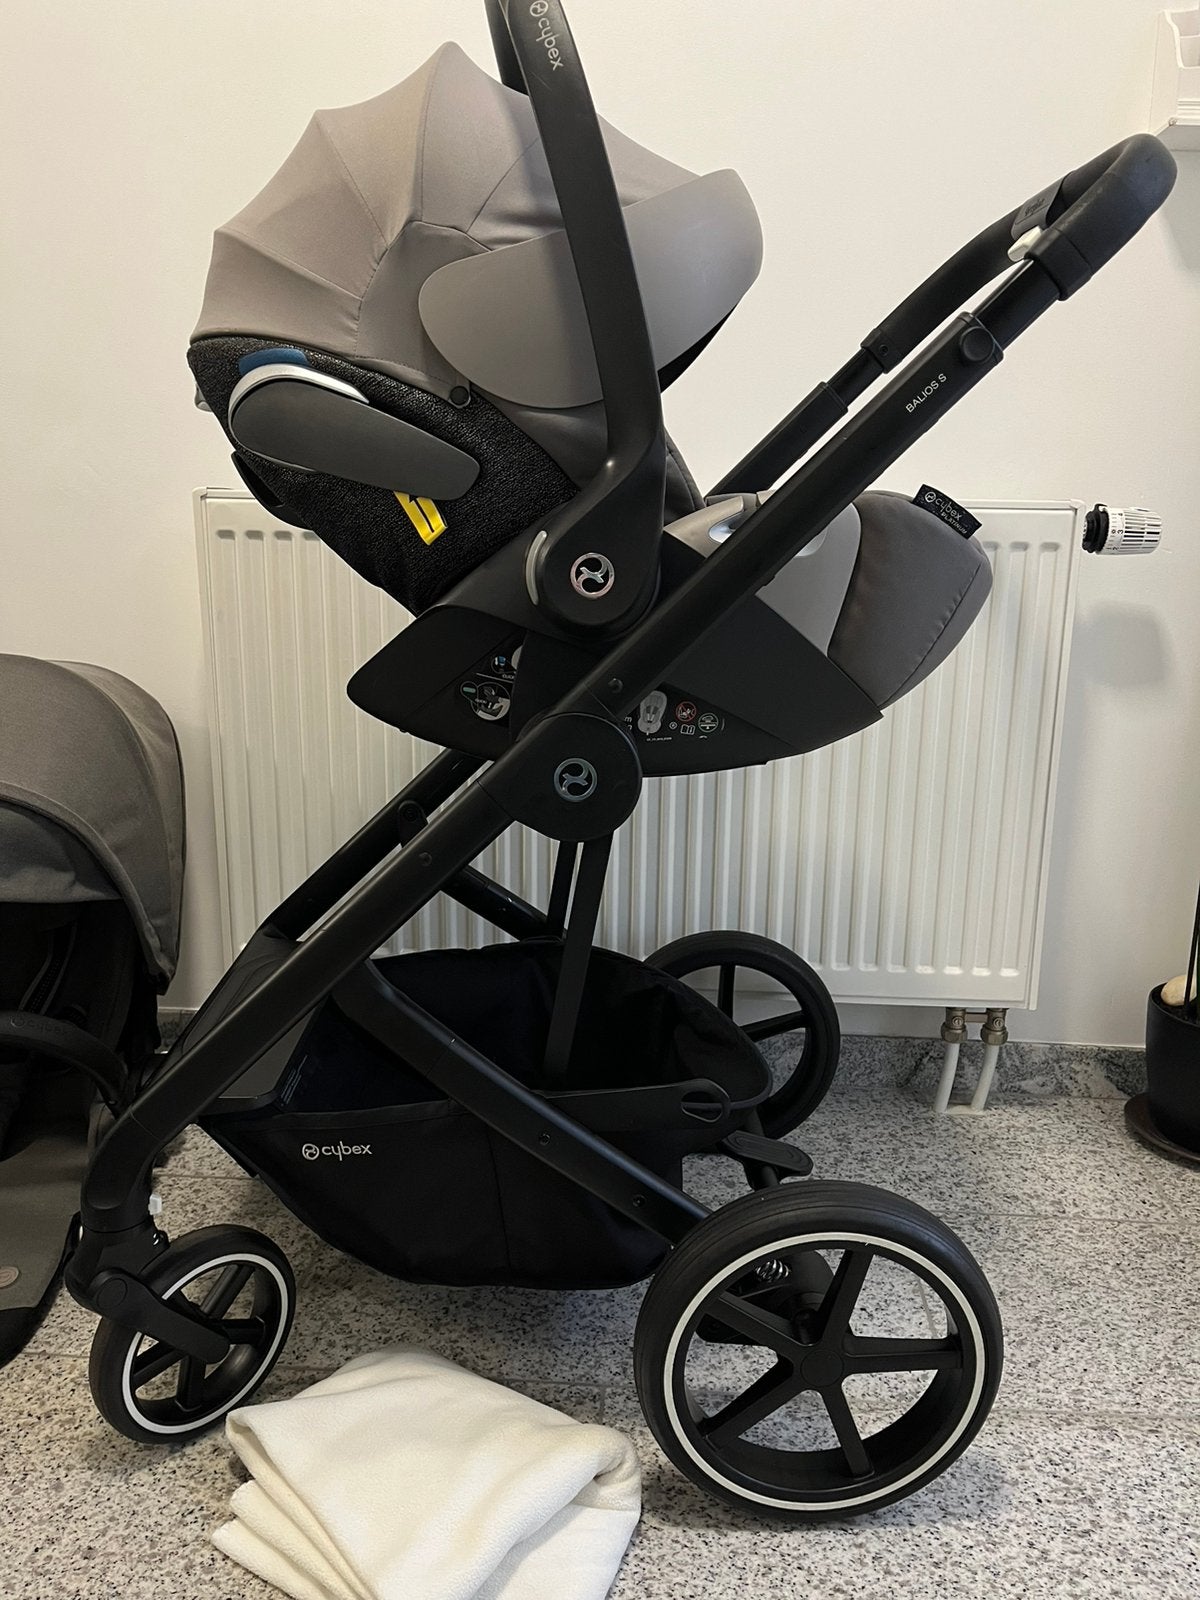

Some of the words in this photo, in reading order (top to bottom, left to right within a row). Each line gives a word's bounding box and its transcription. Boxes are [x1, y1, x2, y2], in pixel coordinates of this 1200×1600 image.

[535, 18, 564, 71] cybex
[905, 380, 939, 413] BALIOS
[938, 373, 947, 383] S
[935, 498, 962, 521] cybex
[940, 511, 967, 534] PLATINUM
[321, 1140, 373, 1161] cybex
